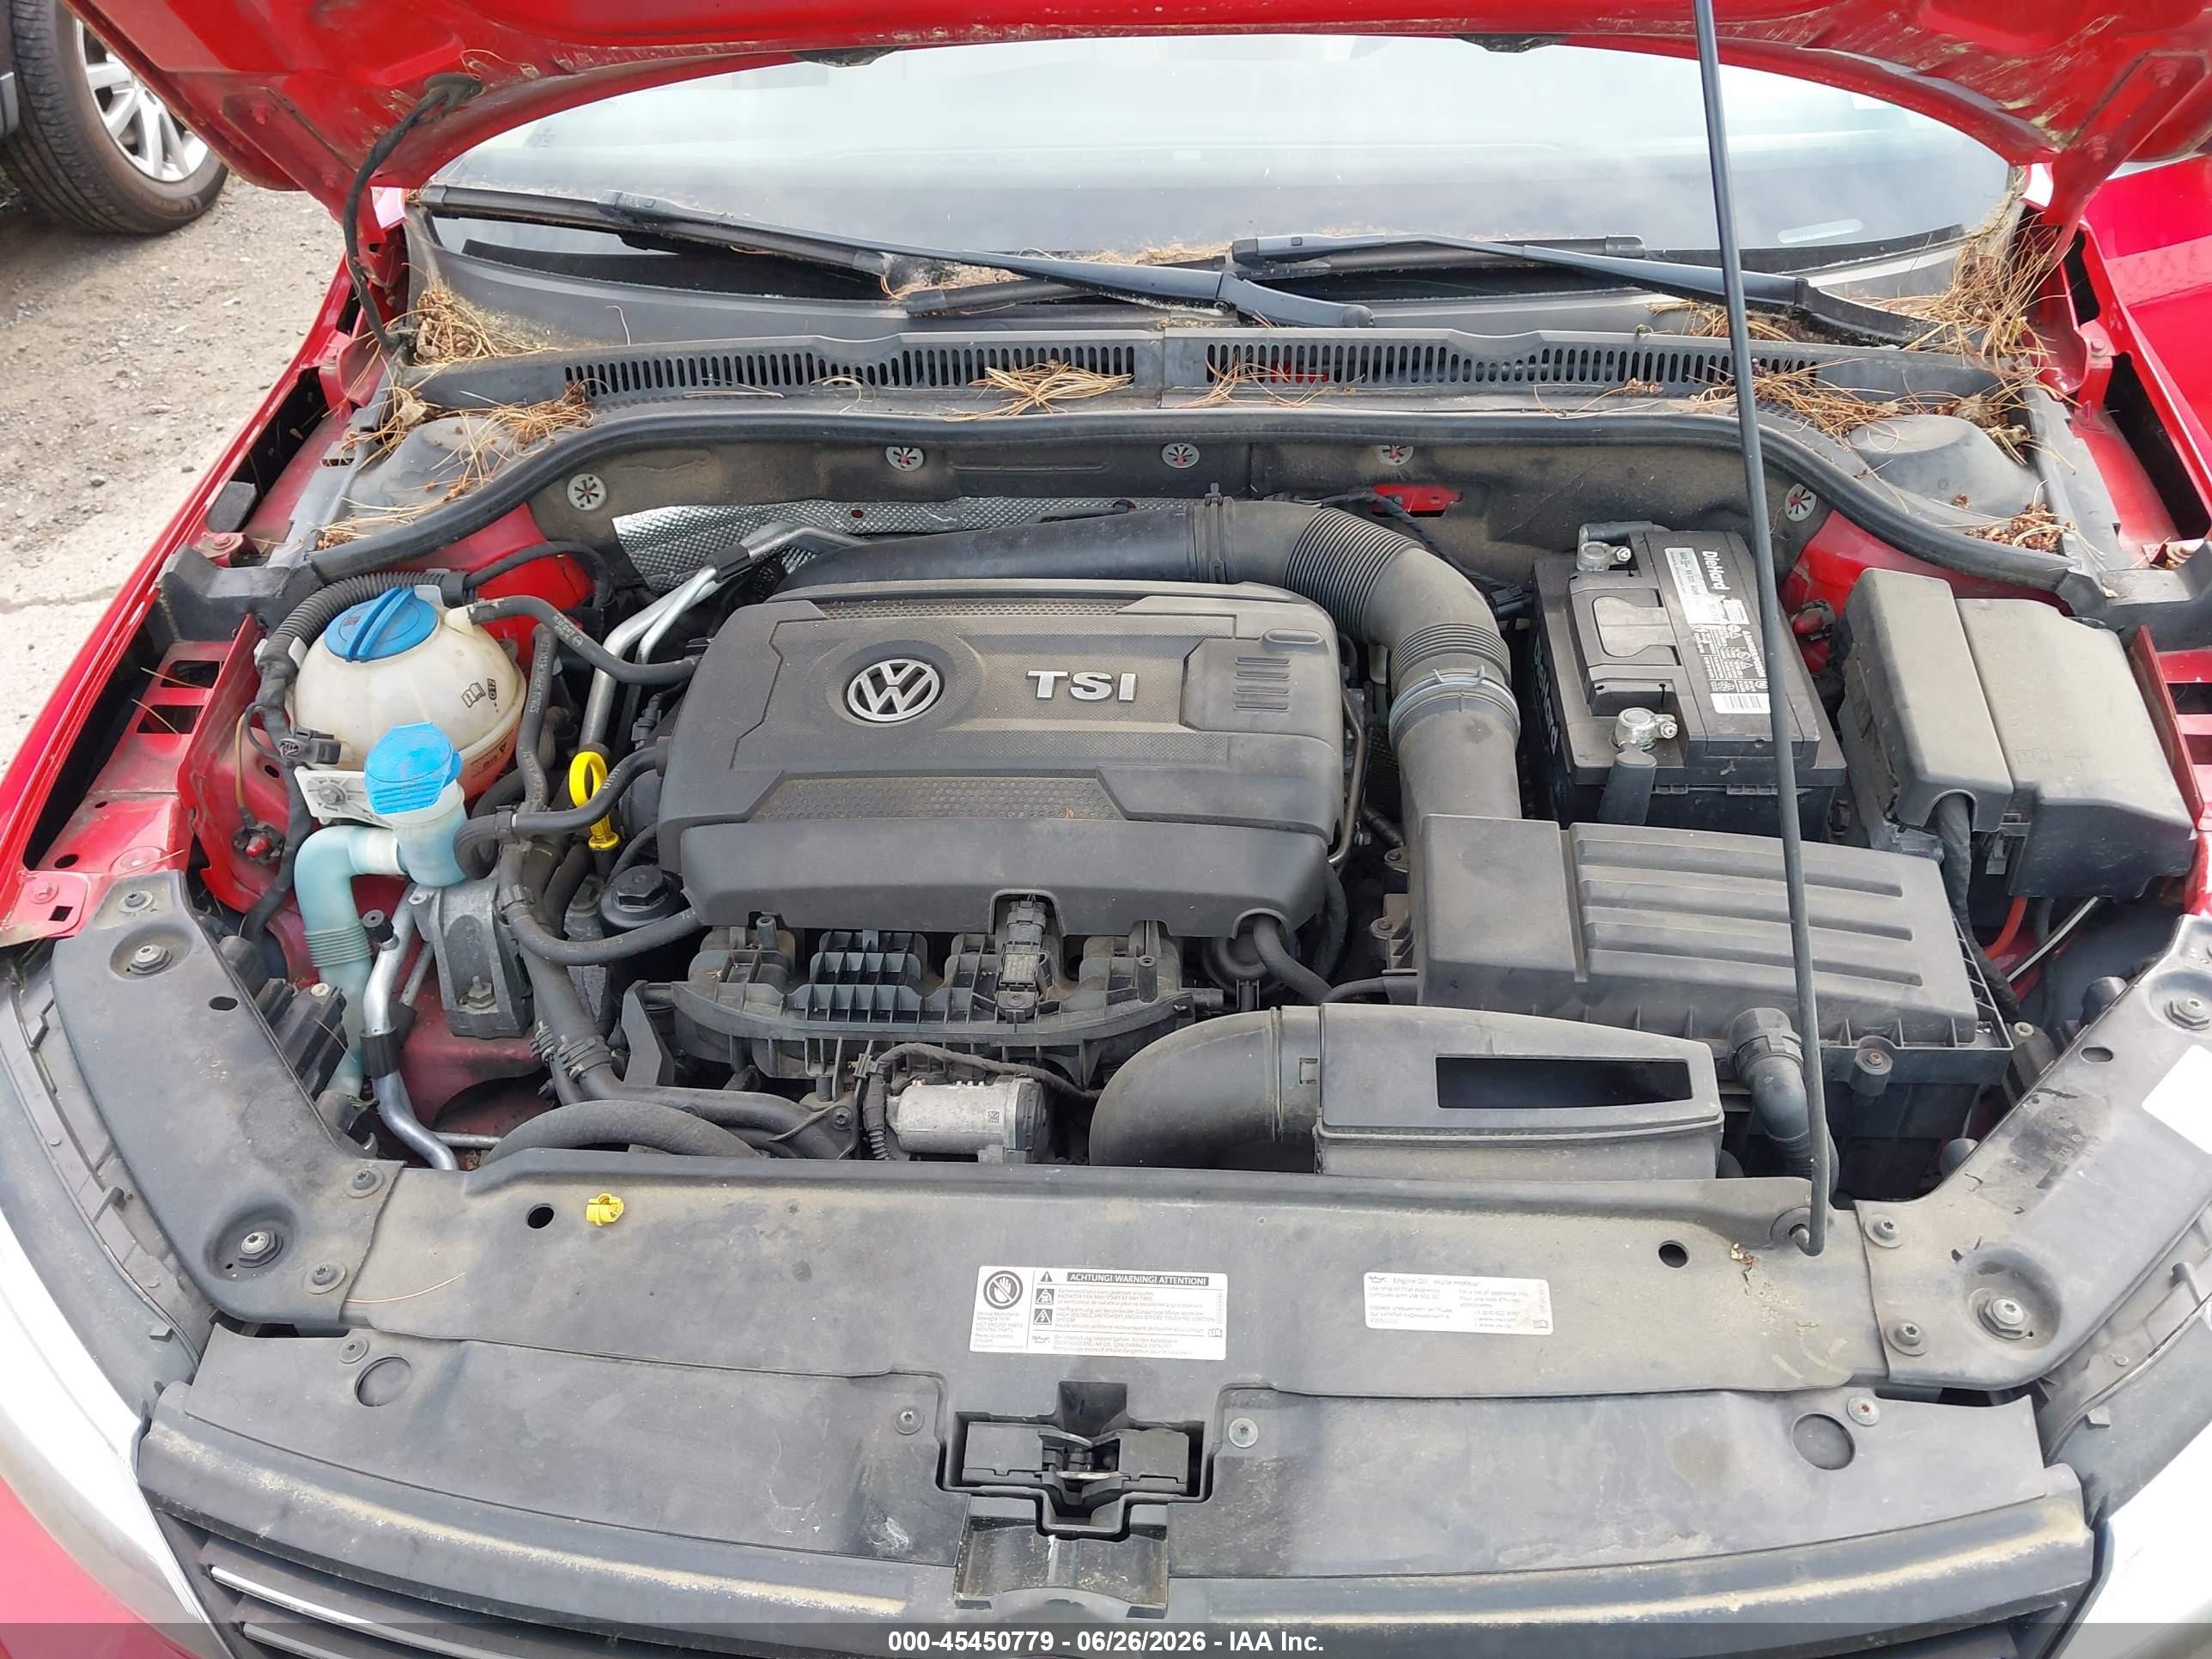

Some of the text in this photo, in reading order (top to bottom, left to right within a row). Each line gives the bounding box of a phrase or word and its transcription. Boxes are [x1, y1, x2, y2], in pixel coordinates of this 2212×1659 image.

[1702, 550, 1731, 591] DieHard
[1028, 670, 1137, 702] TSI
[1070, 1273, 1206, 1285] ACHTUNG! WARNING! ATTENTION!
